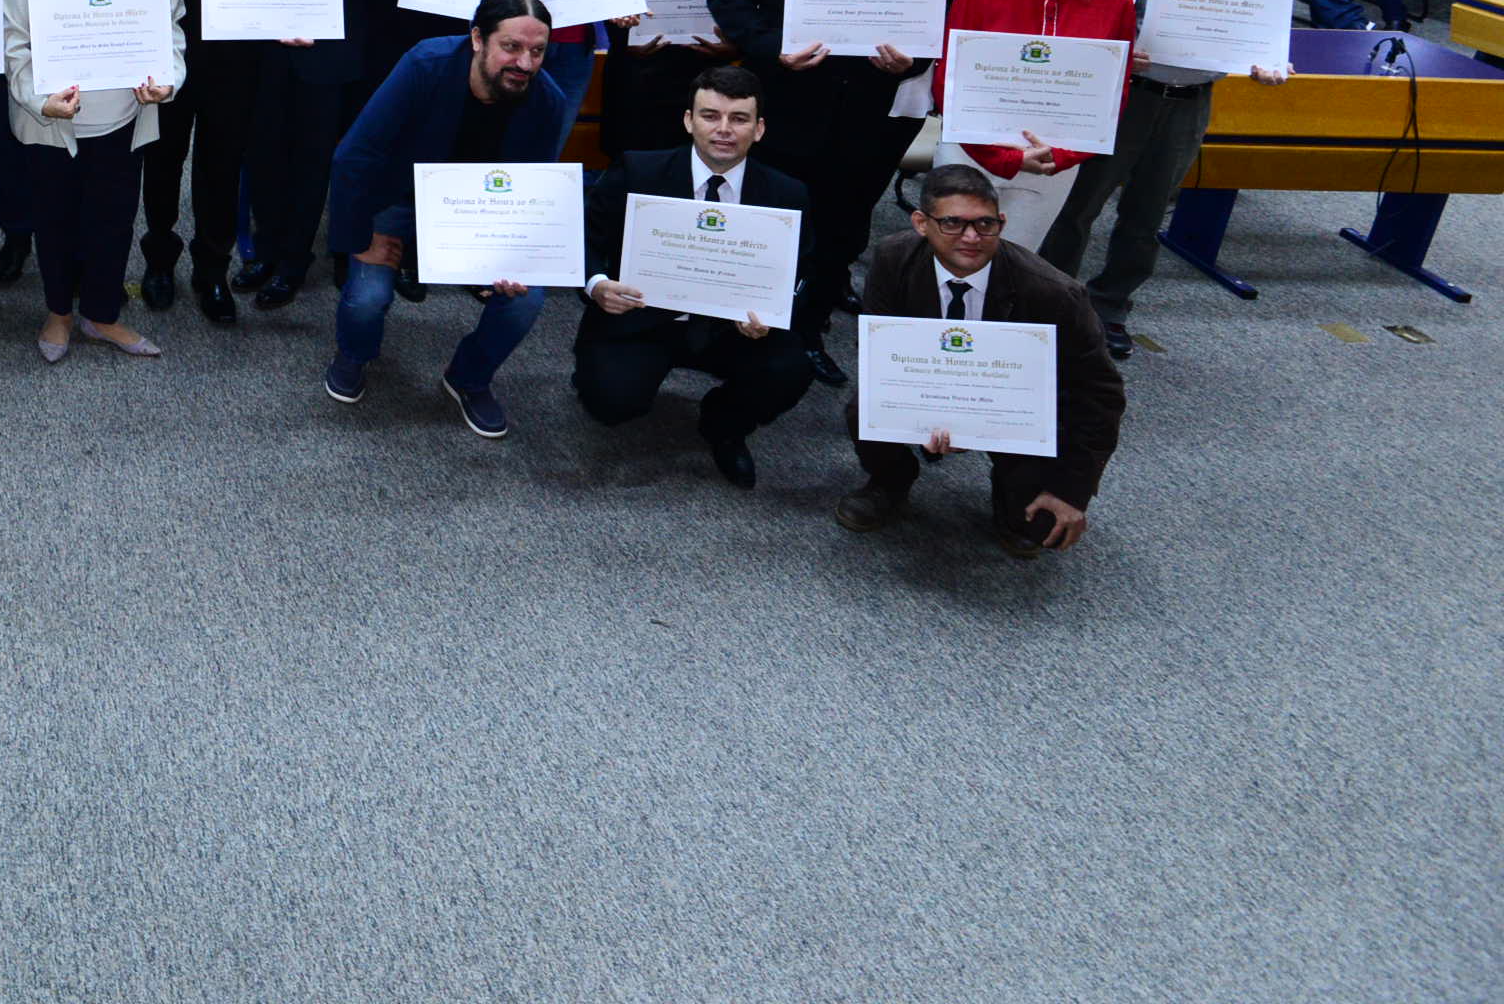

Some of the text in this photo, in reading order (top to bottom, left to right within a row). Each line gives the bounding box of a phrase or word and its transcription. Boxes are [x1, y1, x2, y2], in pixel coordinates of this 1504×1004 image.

[890, 353, 927, 364] Diploma
[945, 357, 974, 366] Honra
[991, 359, 1022, 369] Mérito
